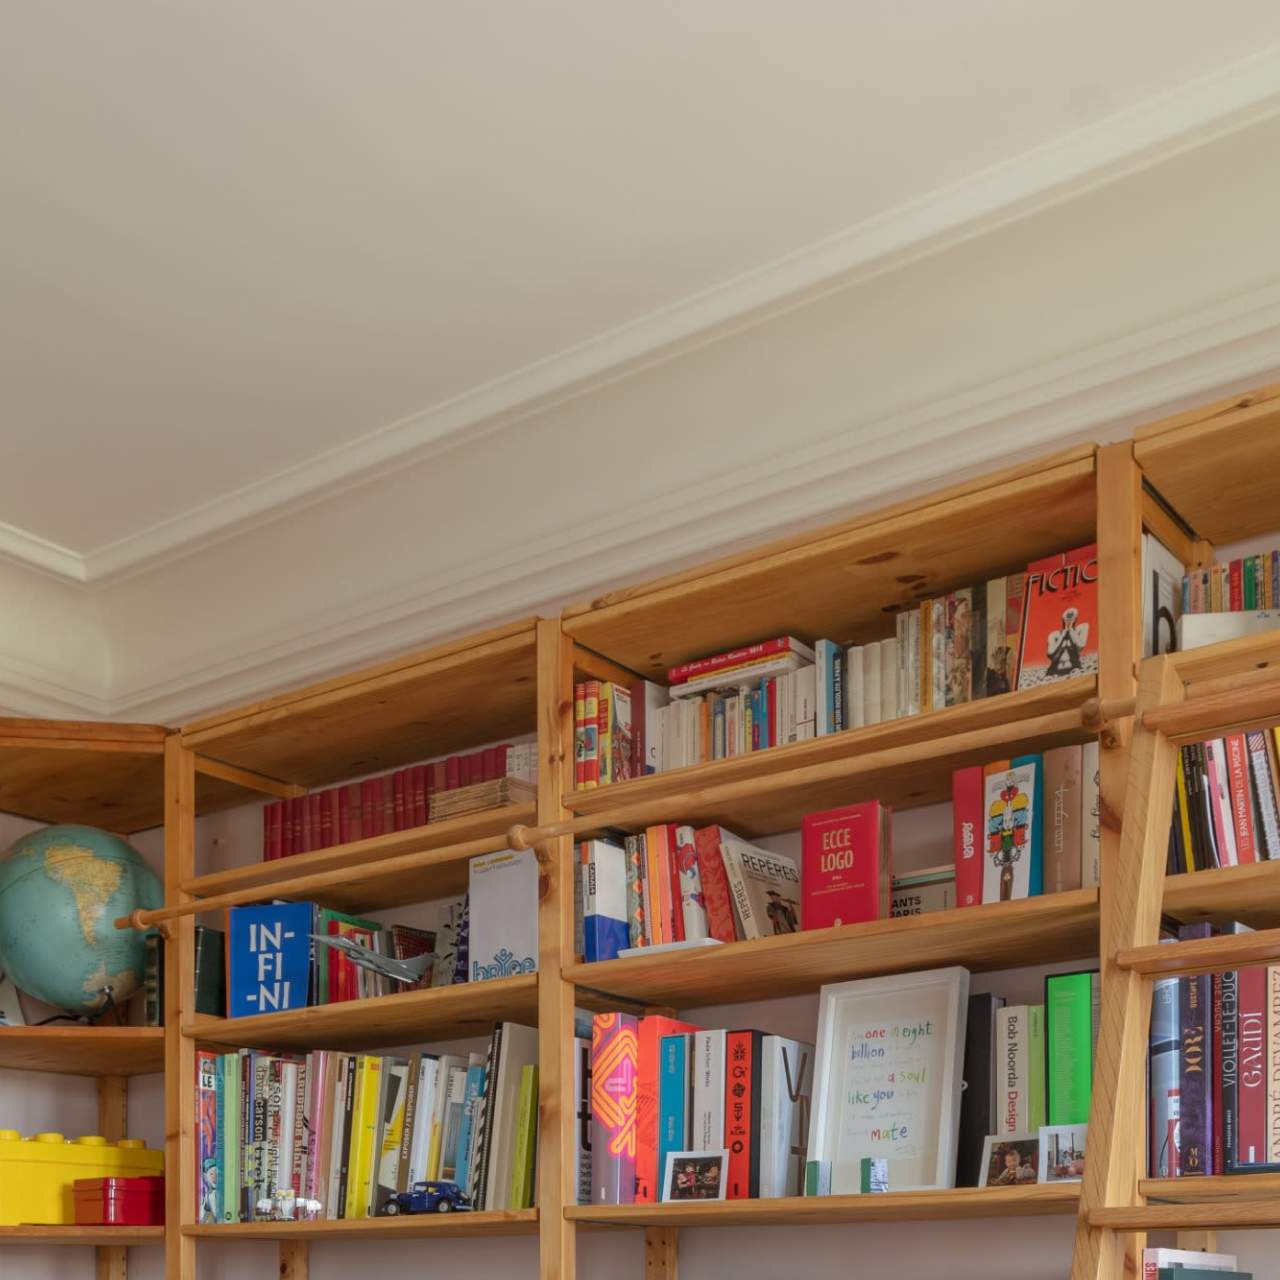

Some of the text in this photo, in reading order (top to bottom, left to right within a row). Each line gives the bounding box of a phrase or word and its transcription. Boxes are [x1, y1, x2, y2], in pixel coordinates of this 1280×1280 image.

[1230, 737, 1248, 837] JEAN MARTIN PISCINE
[822, 828, 852, 851] ECCE
[740, 852, 800, 884] REPÈRES
[820, 849, 854, 873] LOGO
[249, 922, 295, 953] IN-
[258, 952, 283, 982] FI
[246, 981, 290, 1011] -NI
[864, 1020, 933, 1044] one eight
[1222, 971, 1236, 1087] VIOLLET-LE-DUC
[850, 1043, 885, 1060] billion
[1241, 1012, 1263, 1087] GAUDÍ
[202, 1073, 213, 1088] LE
[888, 1069, 926, 1084] a soul
[1008, 1016, 1018, 1132] Bob Noorda Design
[848, 1090, 894, 1110] like you
[255, 1100, 267, 1141] carson
[870, 1122, 908, 1140] mate
